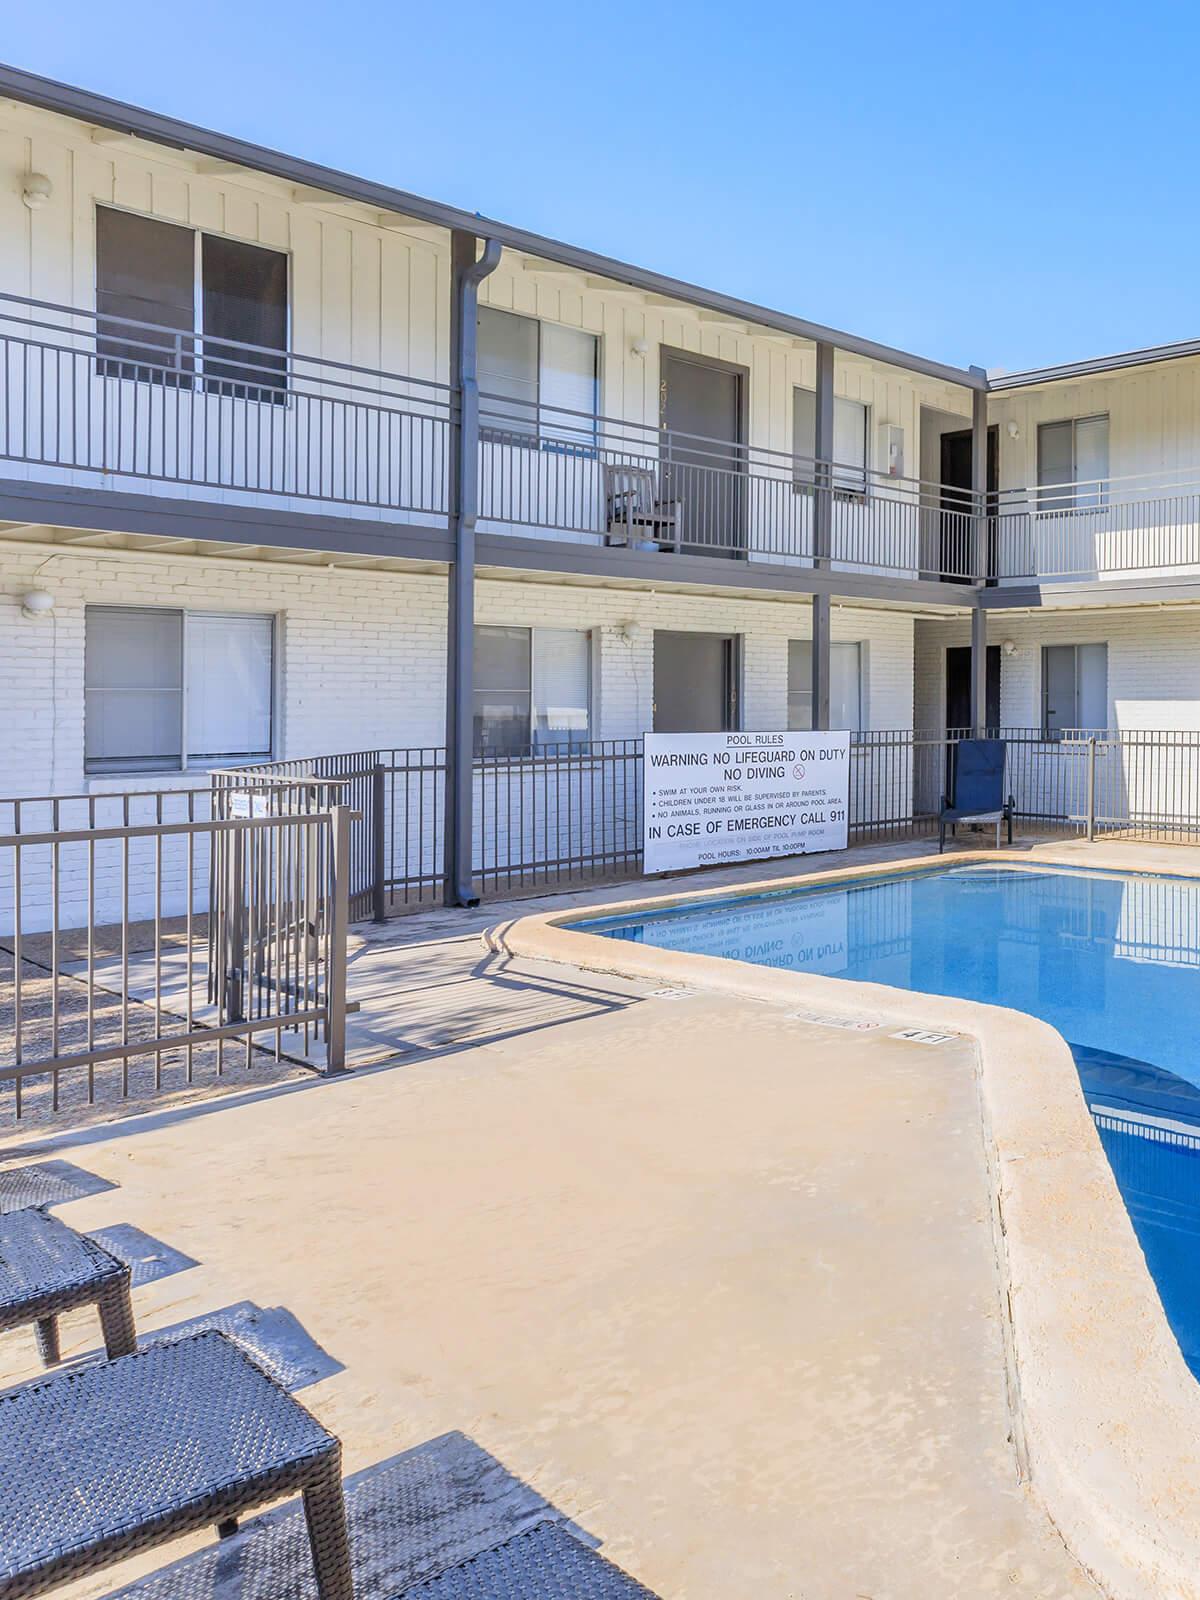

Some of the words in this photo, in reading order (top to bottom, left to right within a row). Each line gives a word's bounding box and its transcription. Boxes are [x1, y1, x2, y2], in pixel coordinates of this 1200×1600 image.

[726, 735, 751, 745] POOL
[755, 734, 784, 744] RULES
[651, 753, 708, 767] WARNING
[713, 752, 730, 765] NO
[735, 750, 796, 764] LIFEGUARD
[800, 749, 815, 761] ON
[819, 748, 846, 761] DUTY
[724, 768, 742, 781] NO
[747, 766, 785, 779] DIVING
[658, 788, 677, 796] SWIM
[679, 787, 687, 795] AT
[710, 785, 725, 793] OWN
[658, 798, 692, 808] CHILDREN
[694, 796, 717, 805] UNDER
[754, 791, 791, 801] SUPERVISED
[657, 811, 668, 819] NO
[703, 806, 732, 815] RUNNING
[745, 803, 766, 812] GLASS
[775, 801, 785, 809] OR
[785, 800, 809, 808] AROUND
[648, 826, 662, 840] IN
[667, 822, 701, 838] CASE
[706, 820, 723, 834] OF
[727, 814, 797, 832] EMERGENCY
[800, 812, 827, 825] CALL
[830, 810, 845, 822] 911
[698, 852, 716, 861] POOL
[902, 1031, 922, 1039] 4
[919, 1034, 952, 1043] FT
